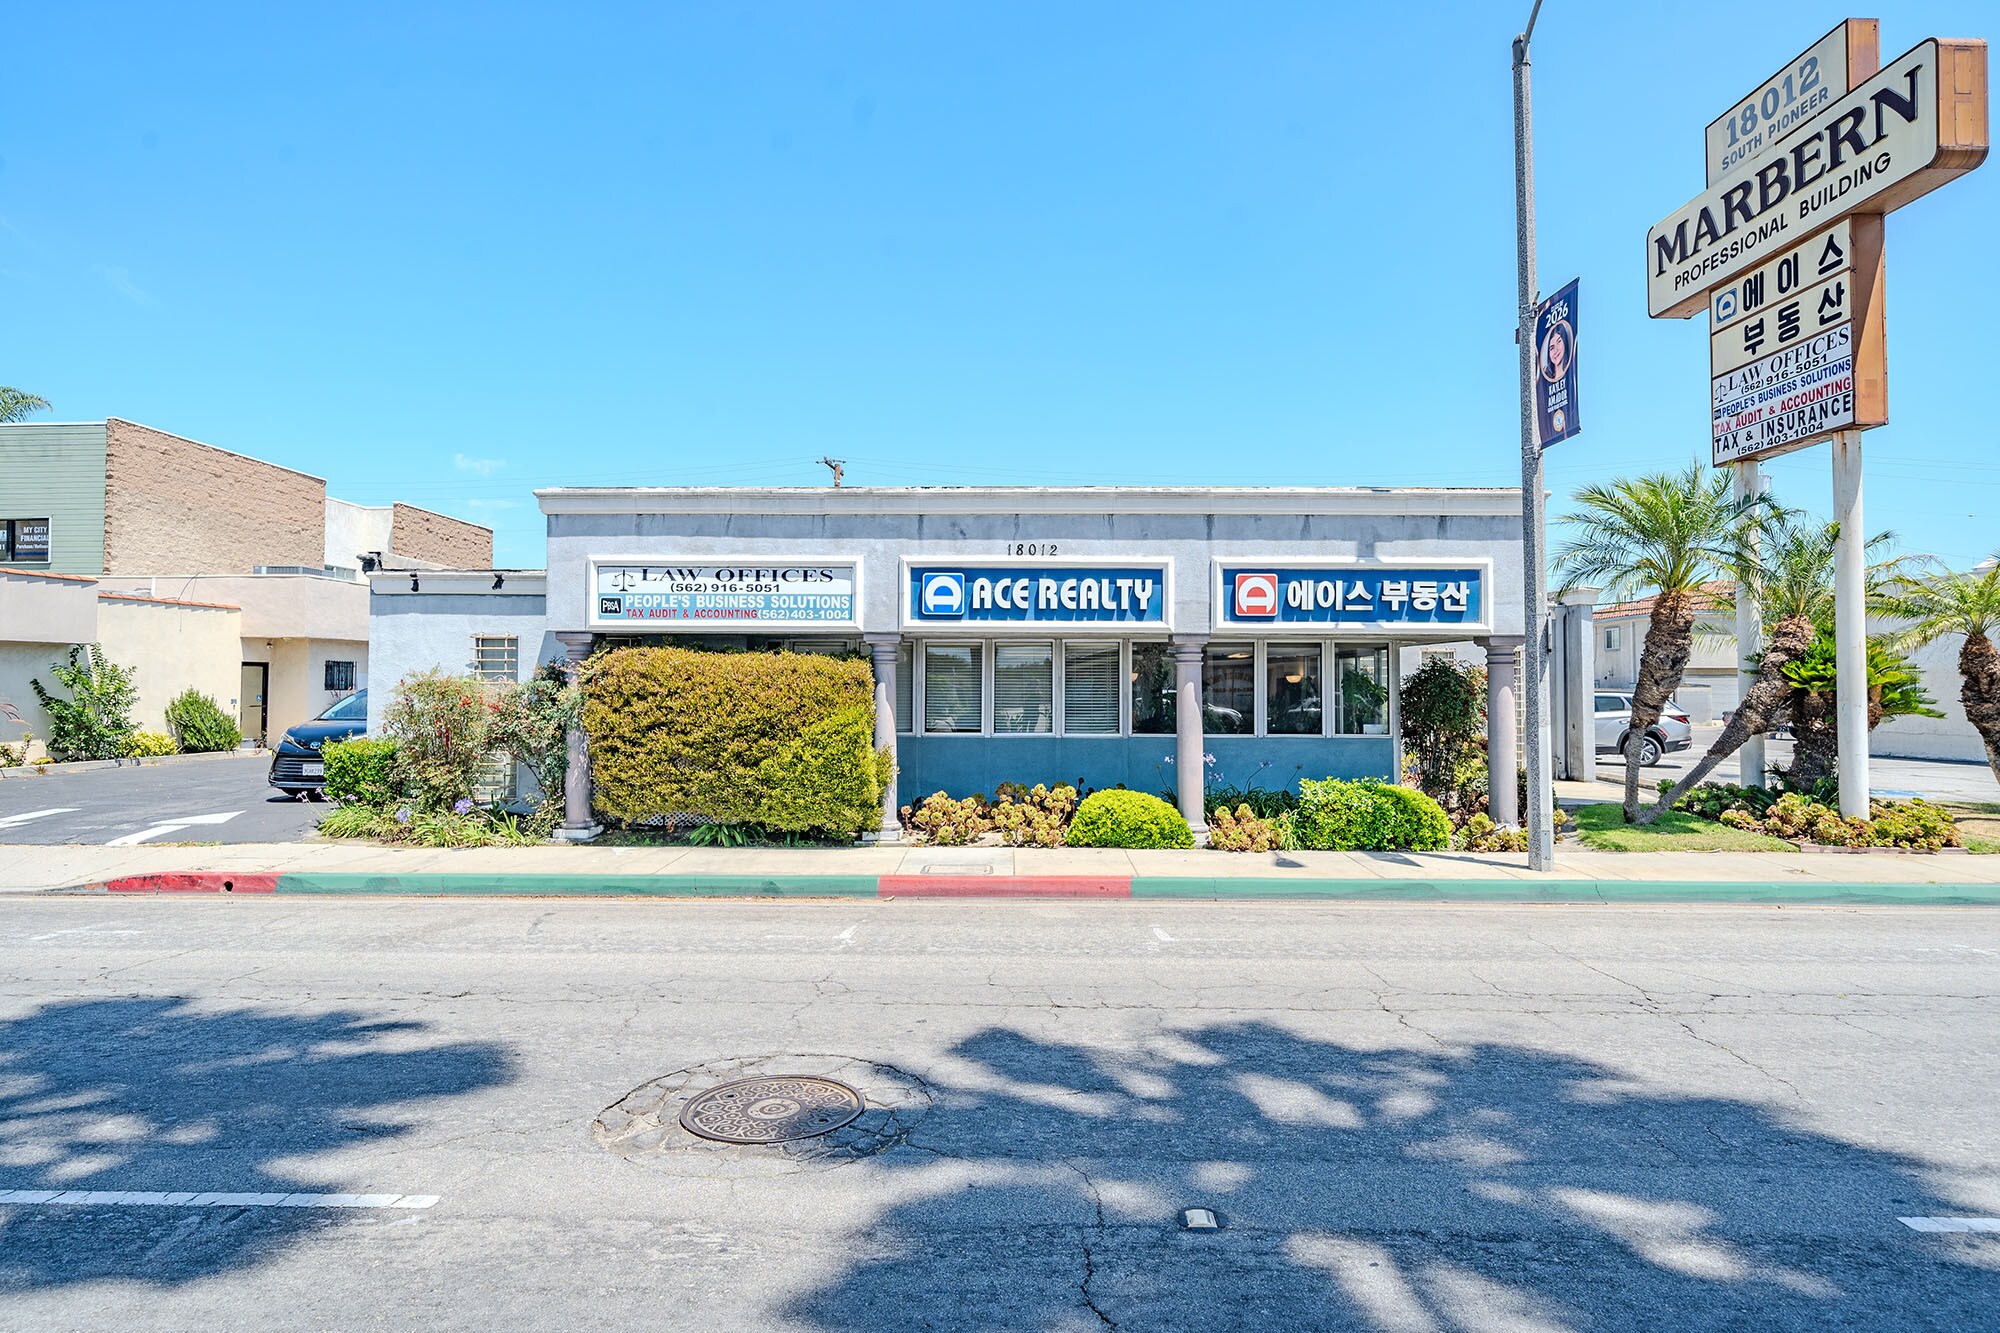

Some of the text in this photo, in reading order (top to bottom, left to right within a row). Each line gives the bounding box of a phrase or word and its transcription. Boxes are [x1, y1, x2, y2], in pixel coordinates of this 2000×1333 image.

[1726, 56, 1821, 148] 18012
[1722, 87, 1829, 170] SOUTH PIONEER
[1654, 64, 1923, 278] MARBERN
[1674, 152, 1892, 291] PROFESSIONAL BUILDING
[1743, 234, 1844, 312] 에이스
[1545, 302, 1568, 328] 2026
[1744, 282, 1845, 356] 부동산
[1729, 327, 1849, 392] LAW OFFICES
[1741, 354, 1827, 395] (562) 916-5051
[1715, 419, 1732, 435] TAX
[1735, 408, 1763, 429] AUDIT
[1768, 405, 1776, 416] &
[1780, 376, 1851, 413] ACCOUNTING
[1722, 395, 1756, 418] PEOPLE'S
[1758, 379, 1797, 404] BUSINESS
[1800, 359, 1851, 387] SOLUTIONS
[1715, 393, 1851, 454] TAX & INSURANCE
[1737, 421, 1824, 456] (562) 403-1004
[1007, 543, 1058, 556] 18012
[641, 568, 834, 583] LAW OFFICES
[670, 583, 780, 593] (562) 916-5051
[972, 578, 1153, 610] ACE REALTY
[1287, 579, 1470, 612] 에이스 부동산
[625, 594, 850, 609] PEOPLE'S BUSINESS SOLUTIONS
[626, 609, 644, 619] TAX
[649, 609, 677, 619] AUDIT
[682, 609, 690, 619] &
[694, 609, 757, 619] ACCOUNTING
